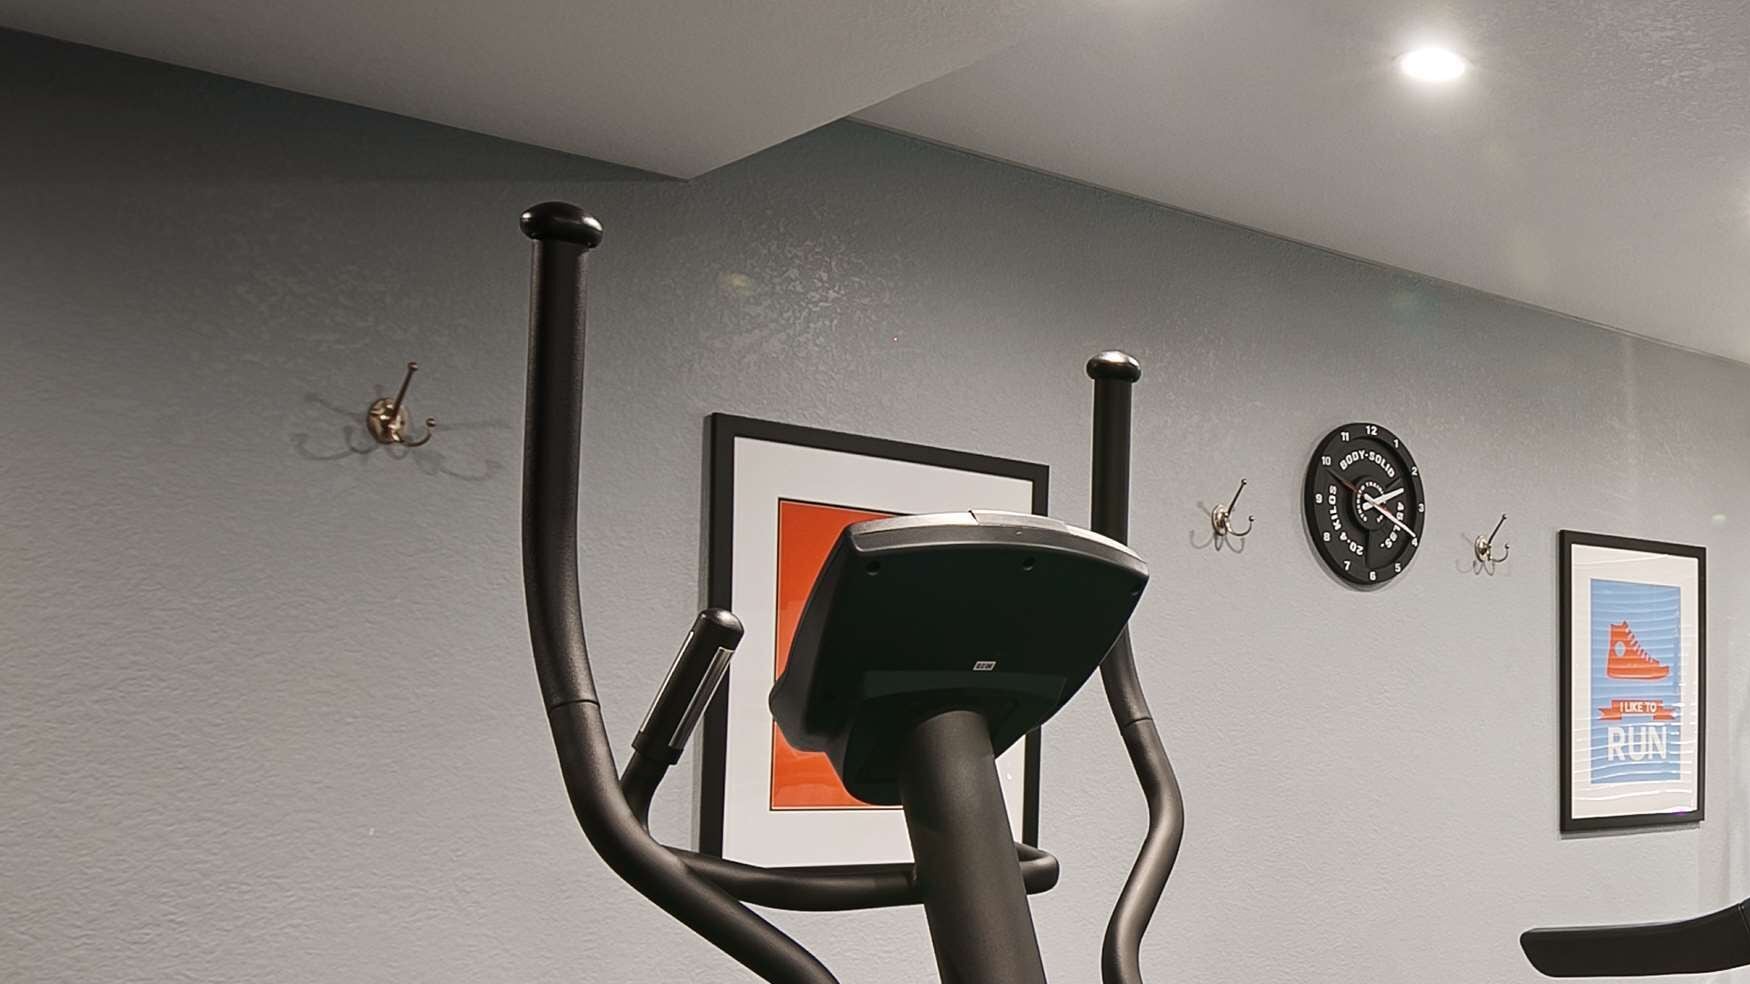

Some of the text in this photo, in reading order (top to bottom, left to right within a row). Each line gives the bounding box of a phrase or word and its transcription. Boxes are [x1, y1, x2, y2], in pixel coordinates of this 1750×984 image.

[1366, 426, 1378, 435] 12
[1341, 432, 1349, 441] 11
[1393, 439, 1399, 448] 1
[1322, 456, 1331, 465] 10
[1411, 466, 1418, 476] 2
[1315, 493, 1323, 503] 9
[1418, 503, 1424, 512] 3
[1323, 532, 1331, 541] 8
[1412, 537, 1418, 547] 4
[1344, 561, 1351, 570] 7
[1395, 563, 1401, 572] 5
[1369, 571, 1376, 581] 6
[1619, 701, 1657, 713] I LIKE TO
[1607, 726, 1667, 761] RUN
